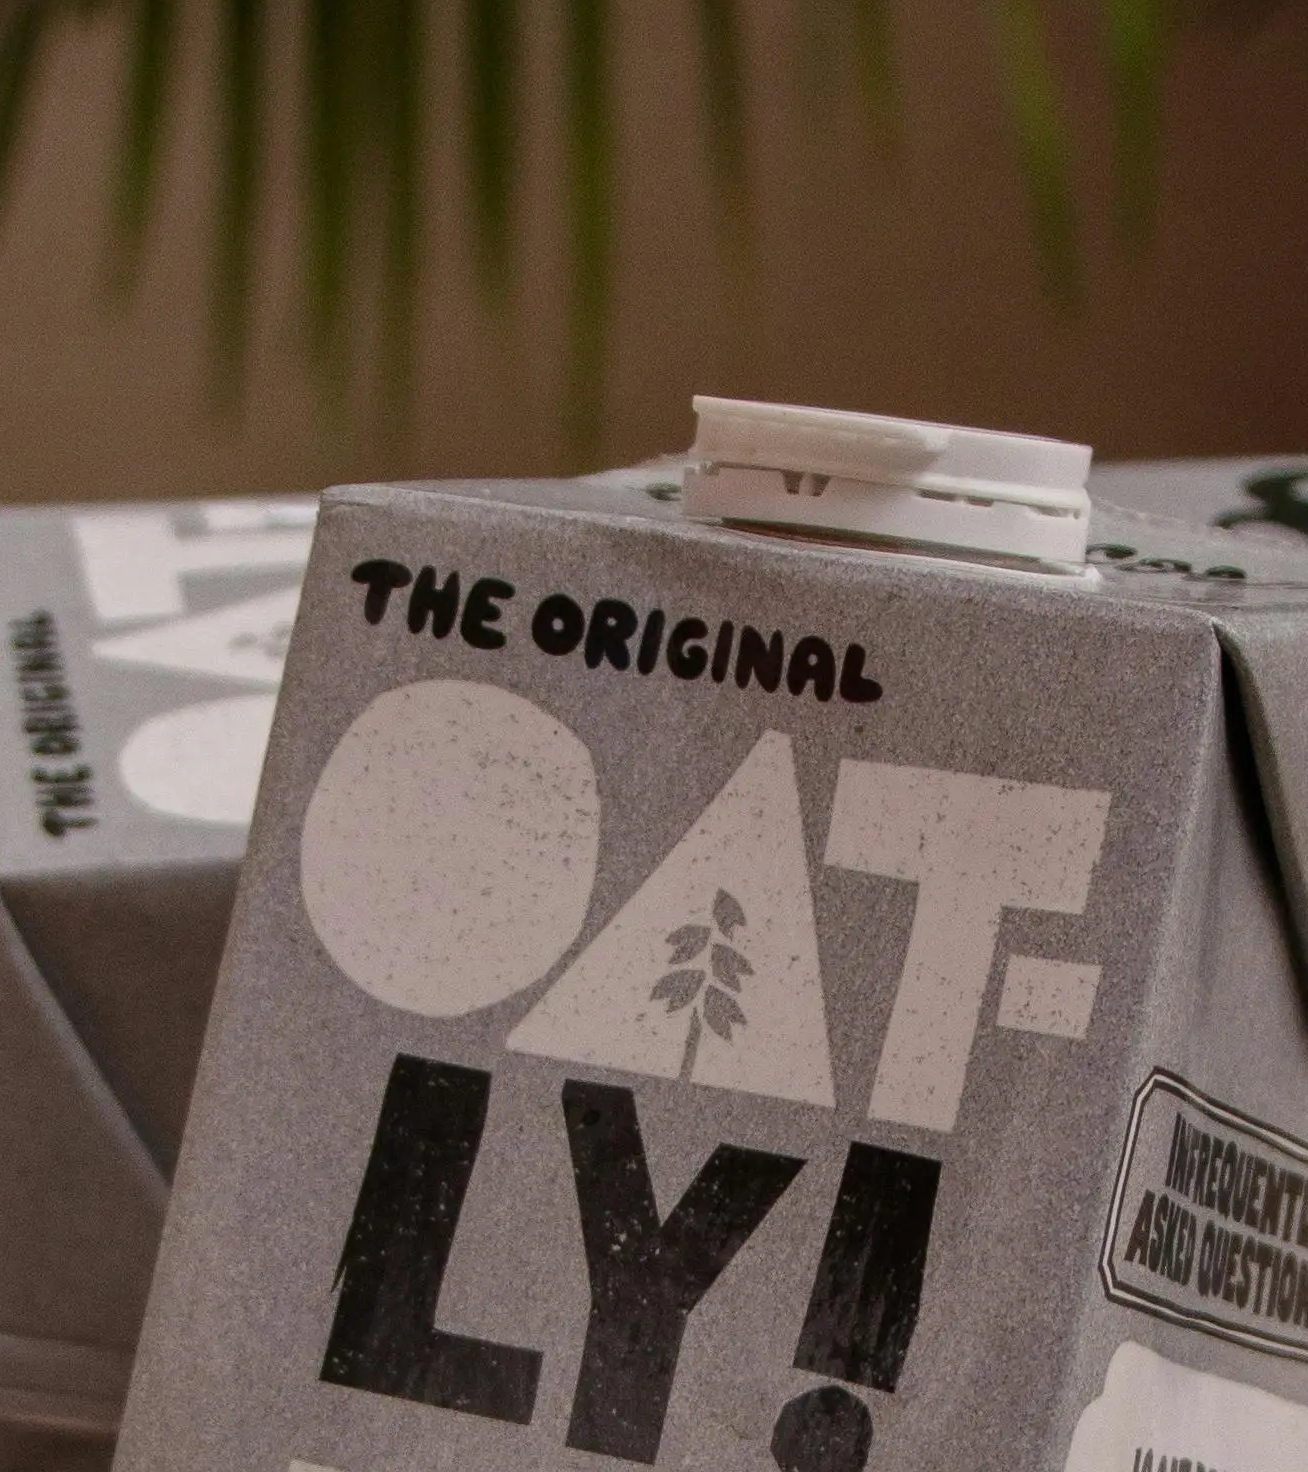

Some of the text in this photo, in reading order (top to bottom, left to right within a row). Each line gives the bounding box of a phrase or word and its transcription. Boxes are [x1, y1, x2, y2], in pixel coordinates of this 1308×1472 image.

[351, 557, 884, 704] THE ORIGINAL
[35, 762, 97, 839] THE
[1123, 1188, 1197, 1286] ASKED
